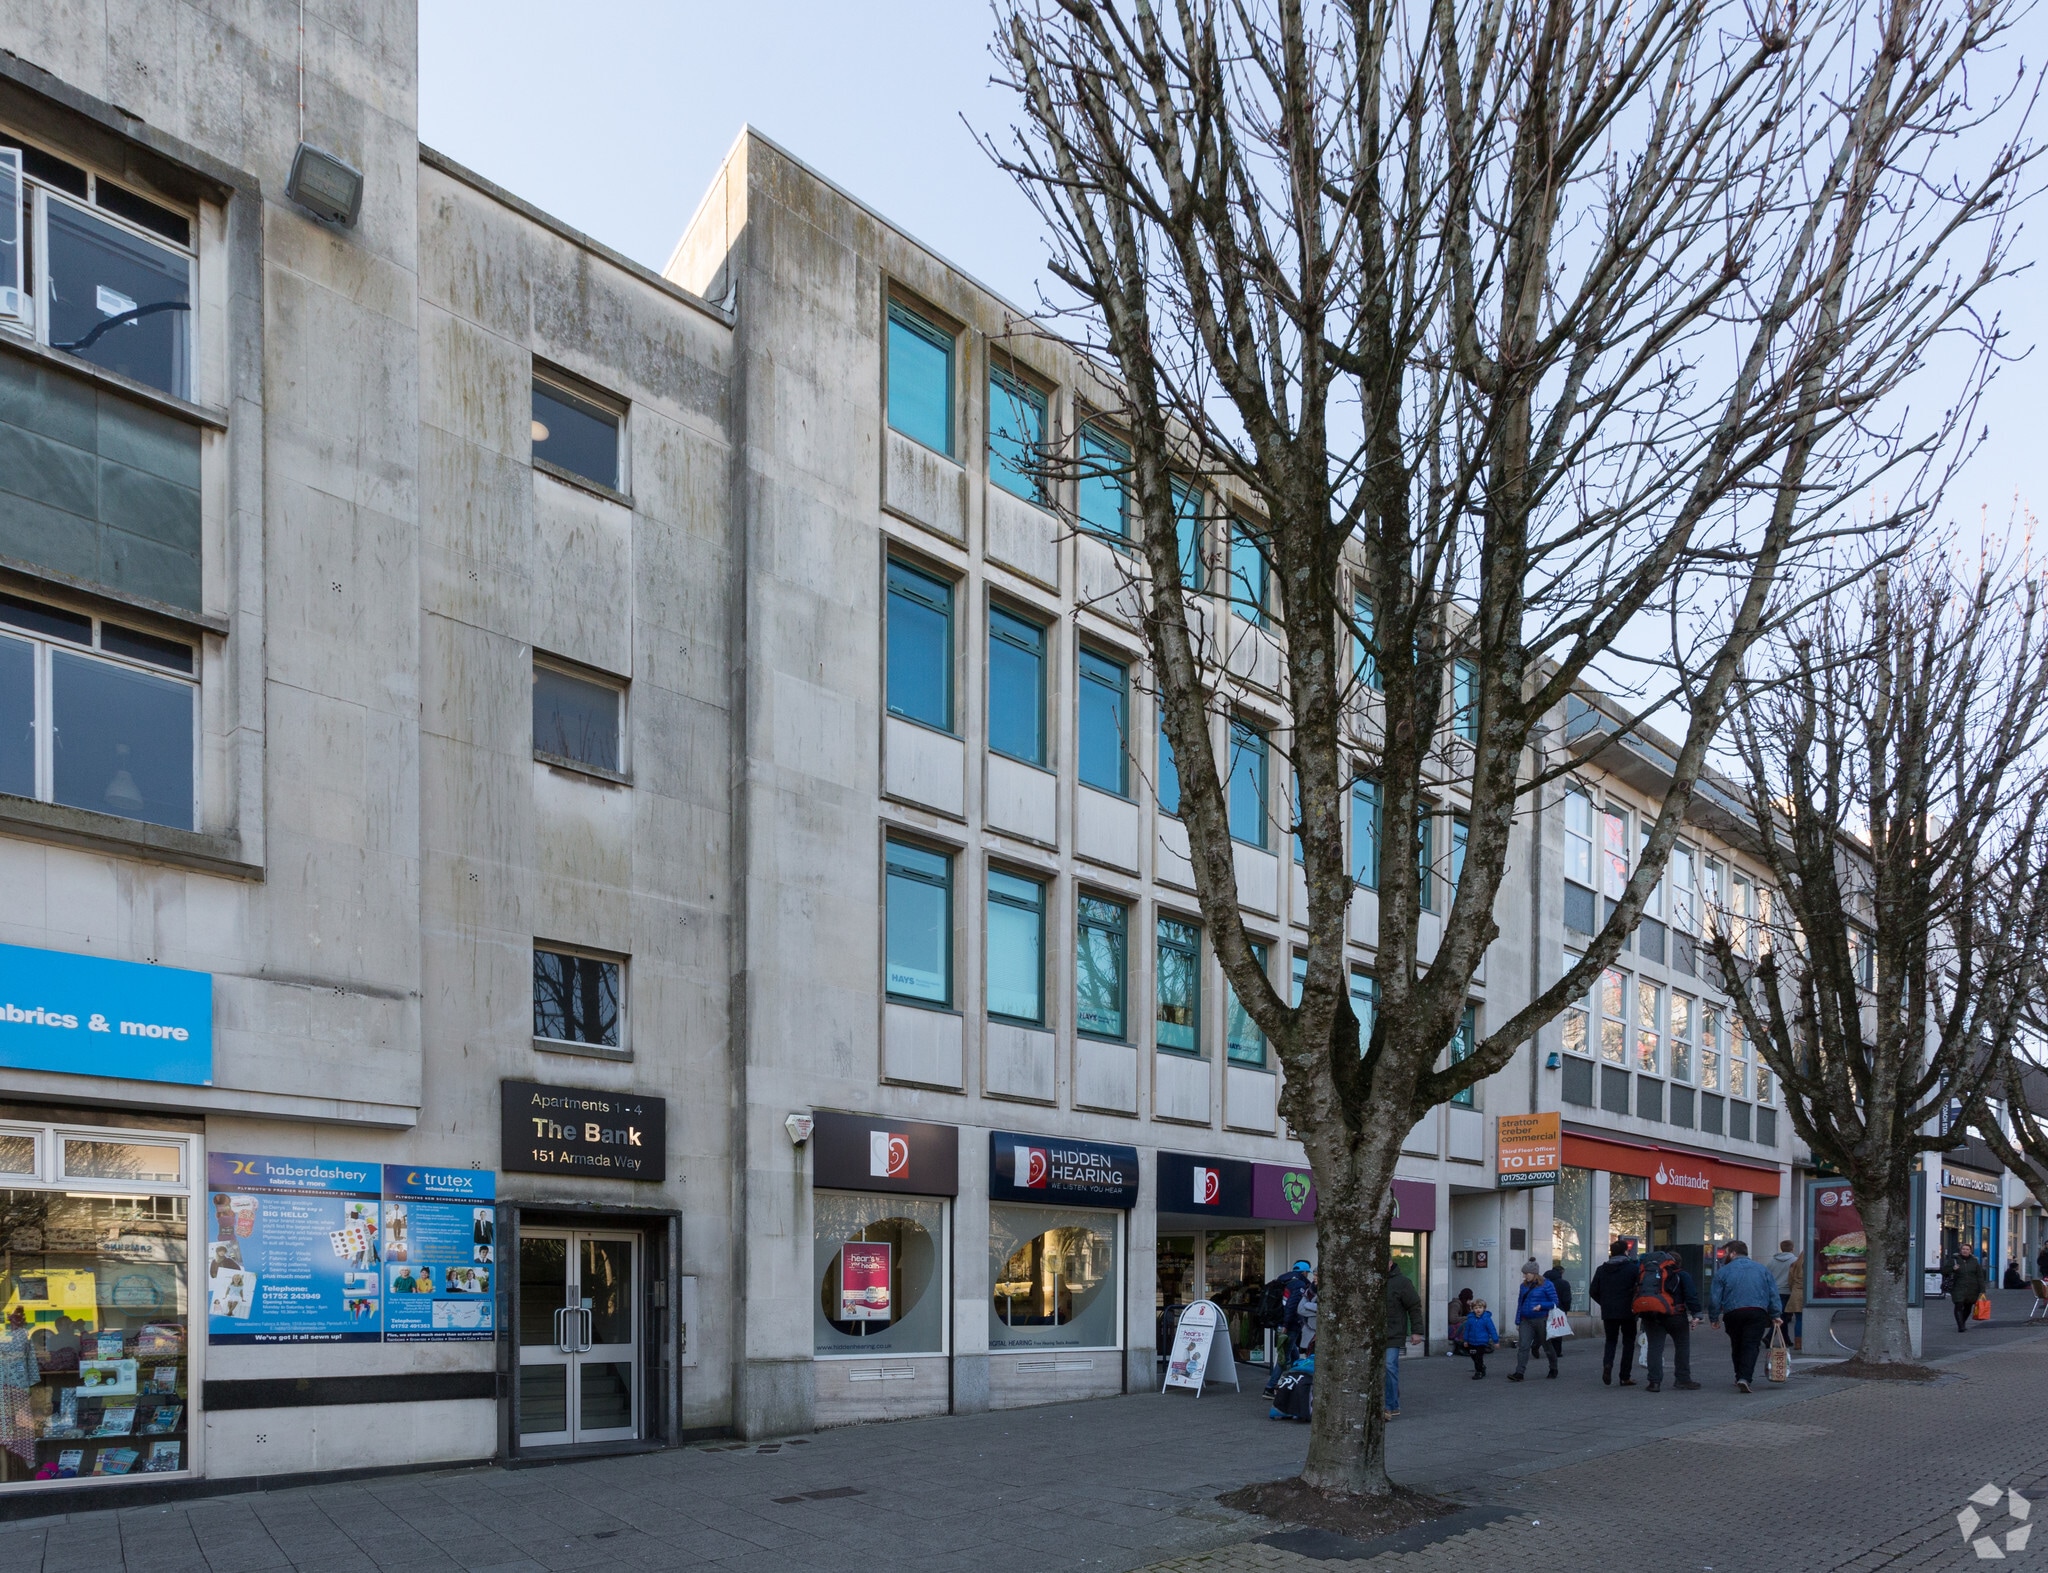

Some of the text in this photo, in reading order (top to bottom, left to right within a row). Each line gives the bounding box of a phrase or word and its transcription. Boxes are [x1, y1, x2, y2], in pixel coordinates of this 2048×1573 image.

[892, 974, 914, 984] HAYS
[88, 1013, 111, 1032] &
[120, 1020, 189, 1041] more
[532, 1093, 610, 1112] Apartments
[614, 1102, 620, 1114] 1
[634, 1104, 643, 1116] 4
[532, 1117, 642, 1146] The Bank
[1502, 1119, 1538, 1128] stratton
[1502, 1127, 1532, 1136] creber
[1502, 1132, 1556, 1143] commercial
[532, 1149, 642, 1172] 151 Armada Way
[1051, 1150, 1112, 1168] HIDDEN
[1502, 1154, 1556, 1168] TO LET
[266, 1162, 367, 1183] haberdashery
[424, 1172, 473, 1187] trutex
[1052, 1165, 1123, 1185] HEARING
[1501, 1173, 1527, 1182] (01752)
[1528, 1172, 1556, 1180] 670700
[1668, 1168, 1710, 1190] Santander
[270, 1178, 296, 1186] fabrics
[1950, 1174, 1998, 1194] PLYMOUTH COACH STATION
[851, 1254, 875, 1263] hear's
[1774, 1351, 1784, 1379] seasalt
